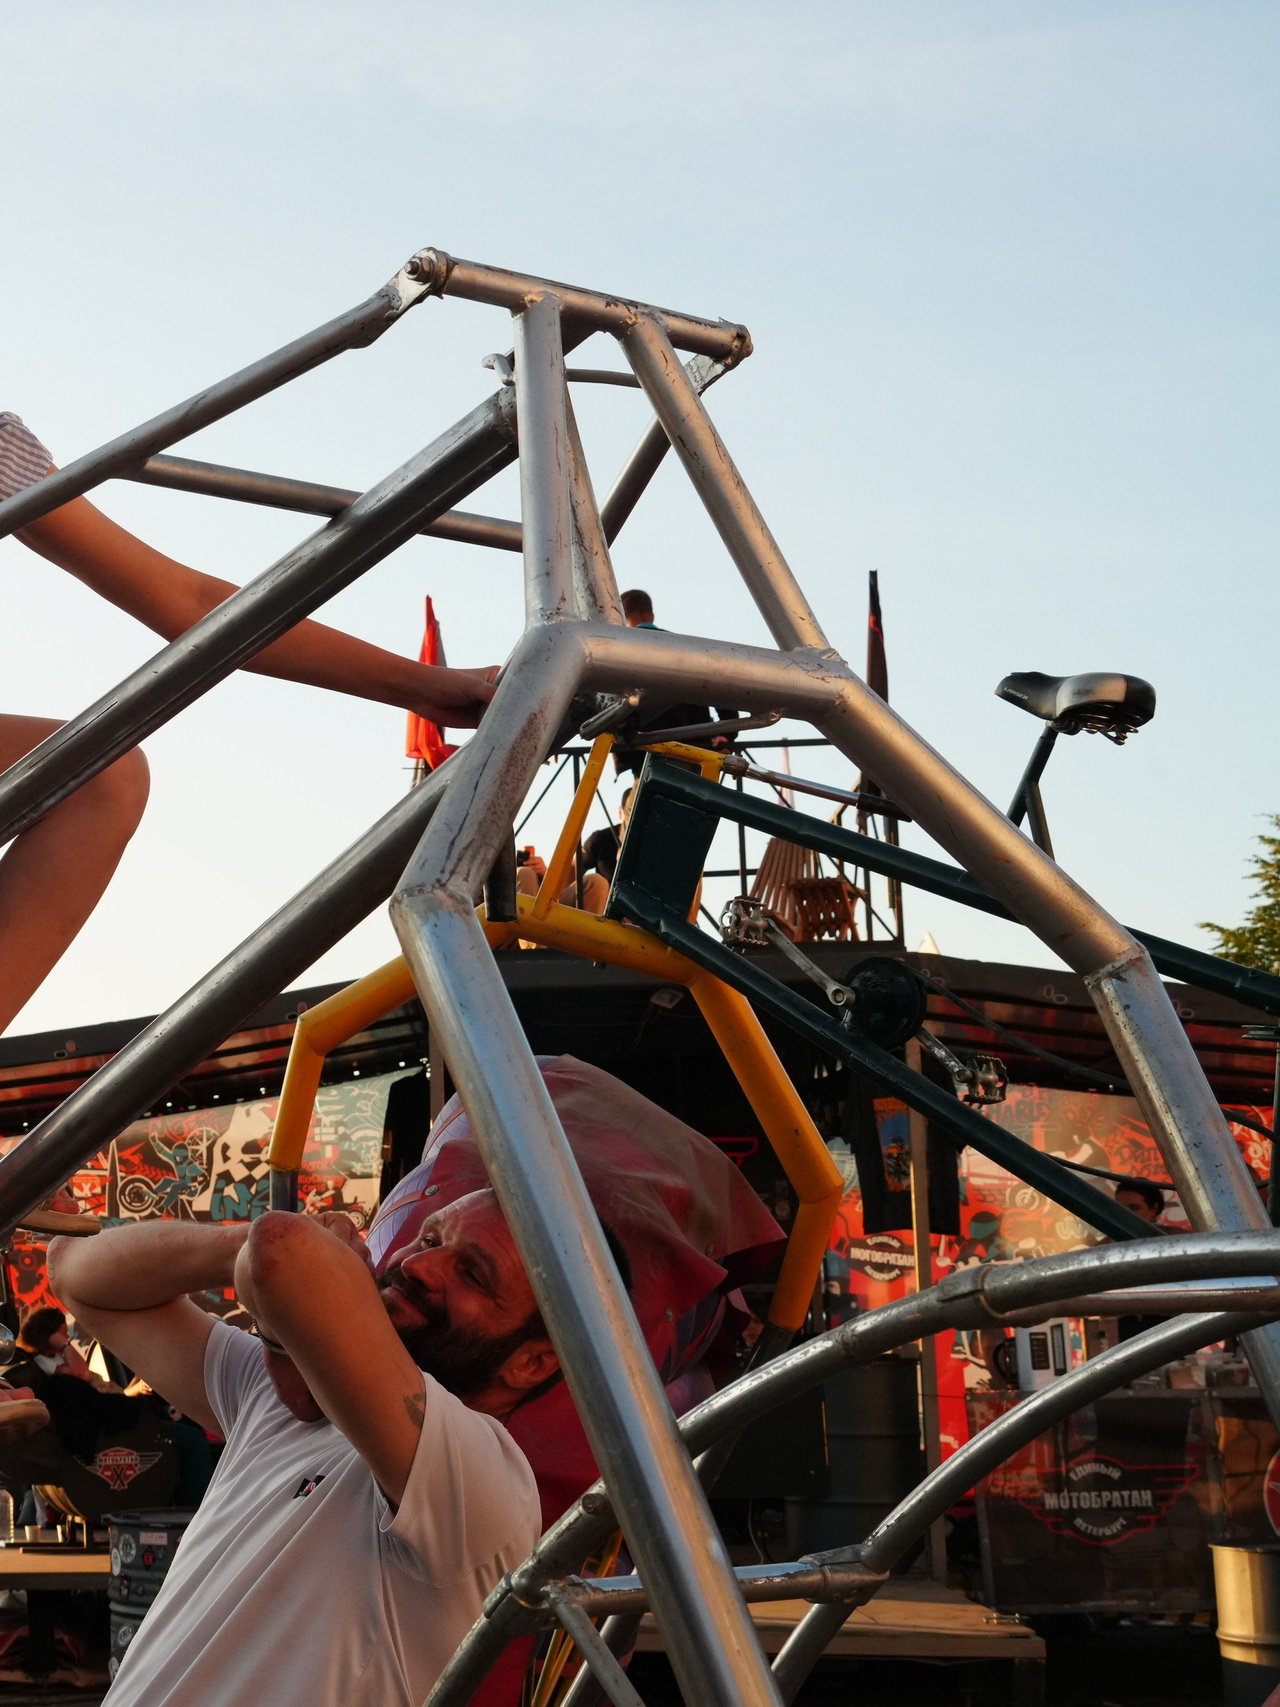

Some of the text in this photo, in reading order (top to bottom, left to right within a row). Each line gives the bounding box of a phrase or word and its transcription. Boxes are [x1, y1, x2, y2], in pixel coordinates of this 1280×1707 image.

[1069, 1462, 1122, 1482] ЕДИНЫЙ
[1043, 1490, 1153, 1510] МОТОБРАТАН
[1073, 1517, 1128, 1537] ПЕТЕРБУРГ
